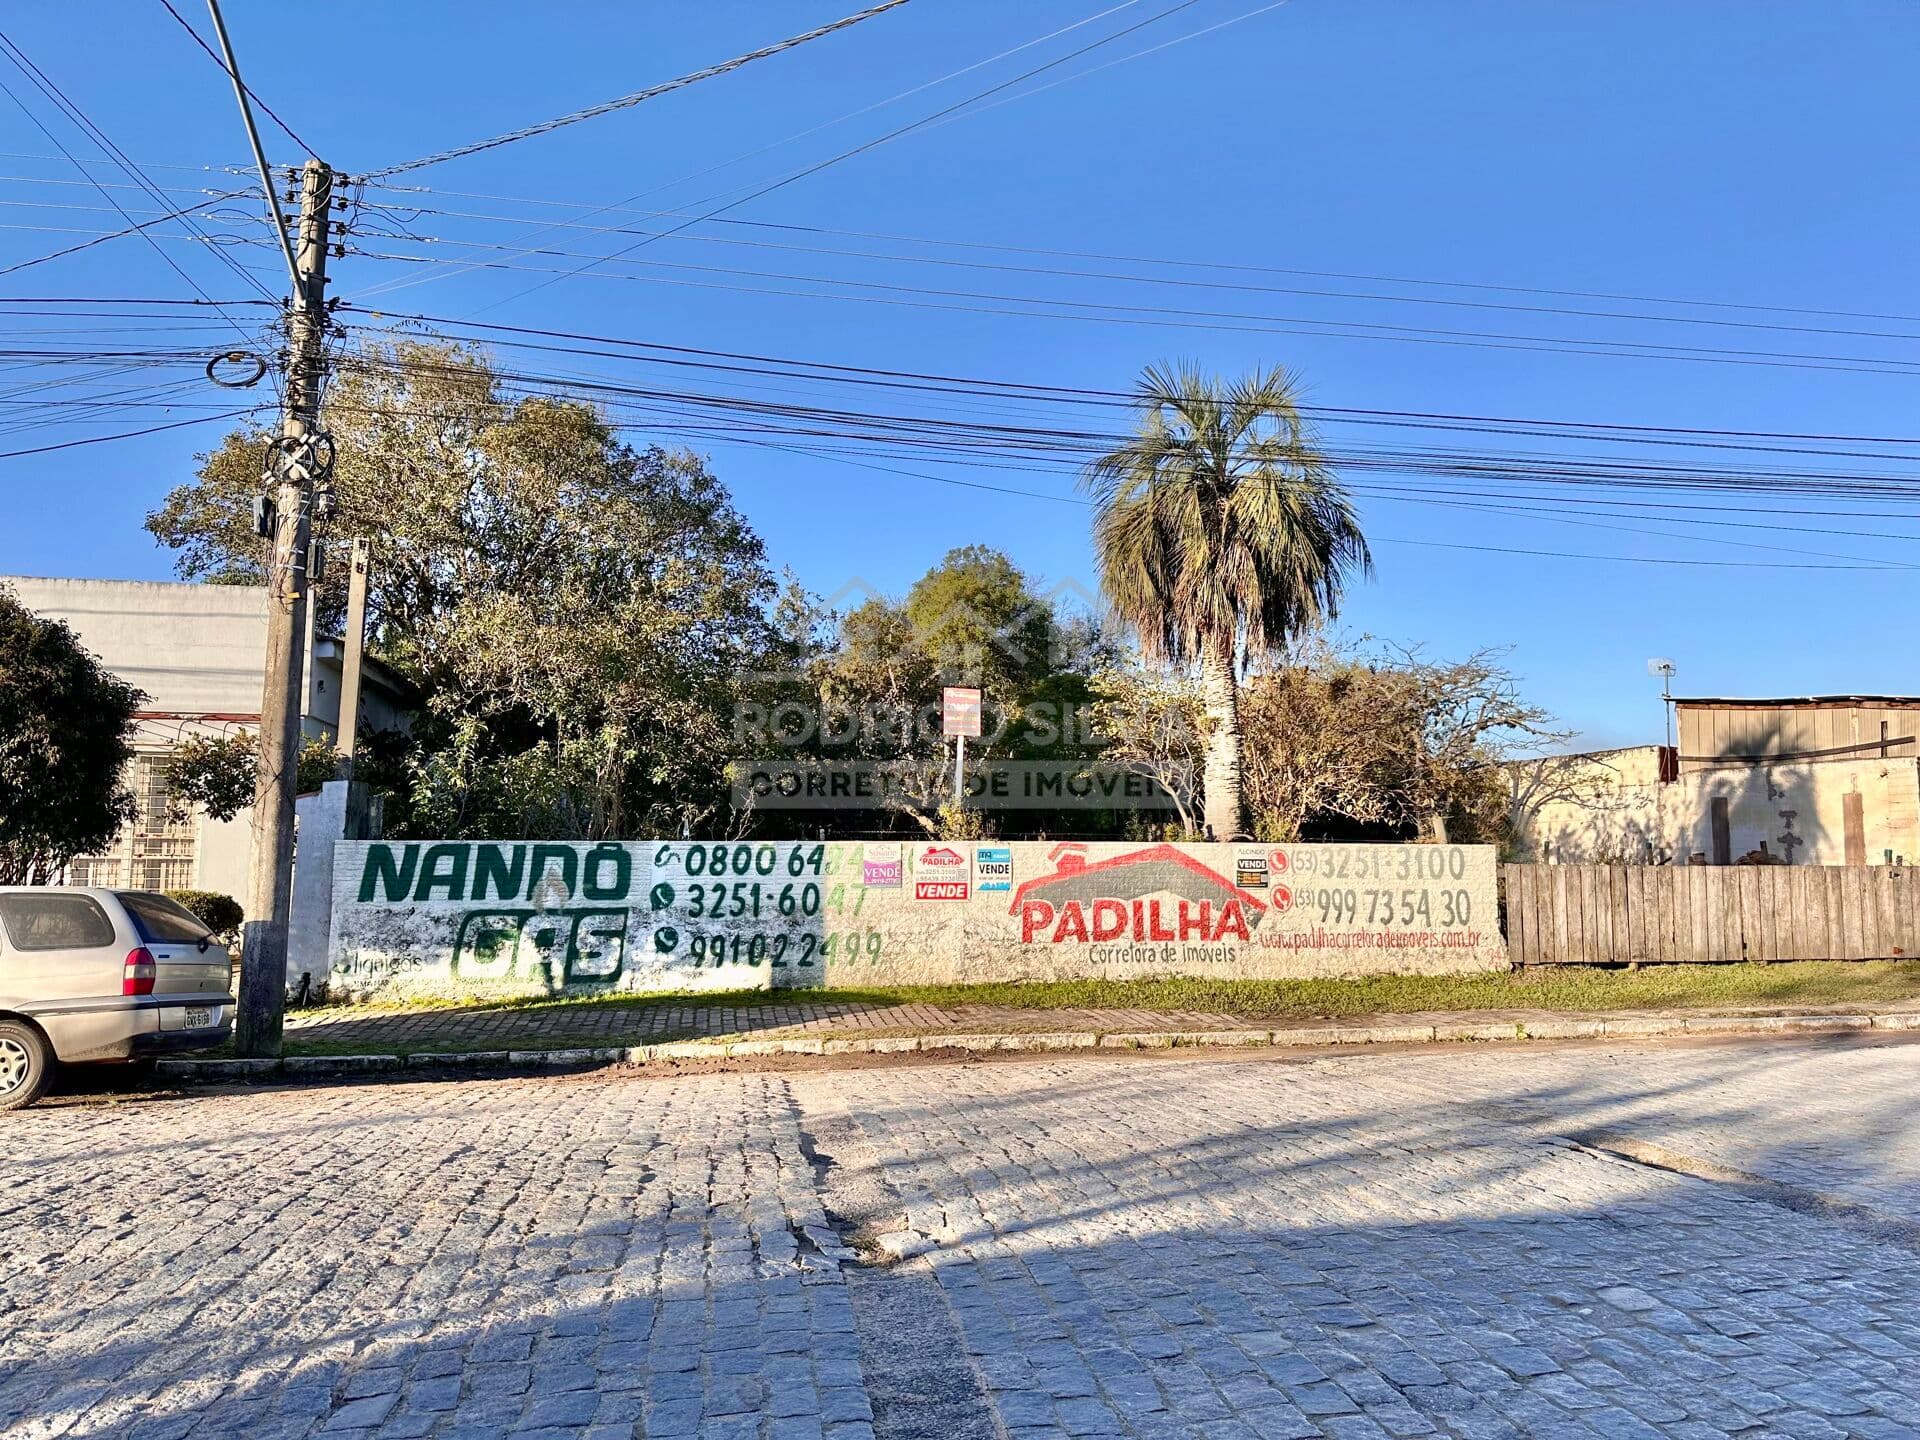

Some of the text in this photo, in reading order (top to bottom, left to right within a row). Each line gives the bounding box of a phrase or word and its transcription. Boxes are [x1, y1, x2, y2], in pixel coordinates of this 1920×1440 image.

[685, 844, 776, 876] 0800
[922, 857, 961, 866] PADILHA
[1239, 860, 1266, 869] VENDE
[1291, 850, 1318, 873] (53)
[864, 867, 901, 878] VENDE
[979, 863, 1010, 874] VENDE
[917, 884, 966, 898] VENDE
[1295, 889, 1315, 908] (53)
[1022, 900, 1249, 943] PADILHA
[1089, 942, 1236, 964] Corretora de imóveis
